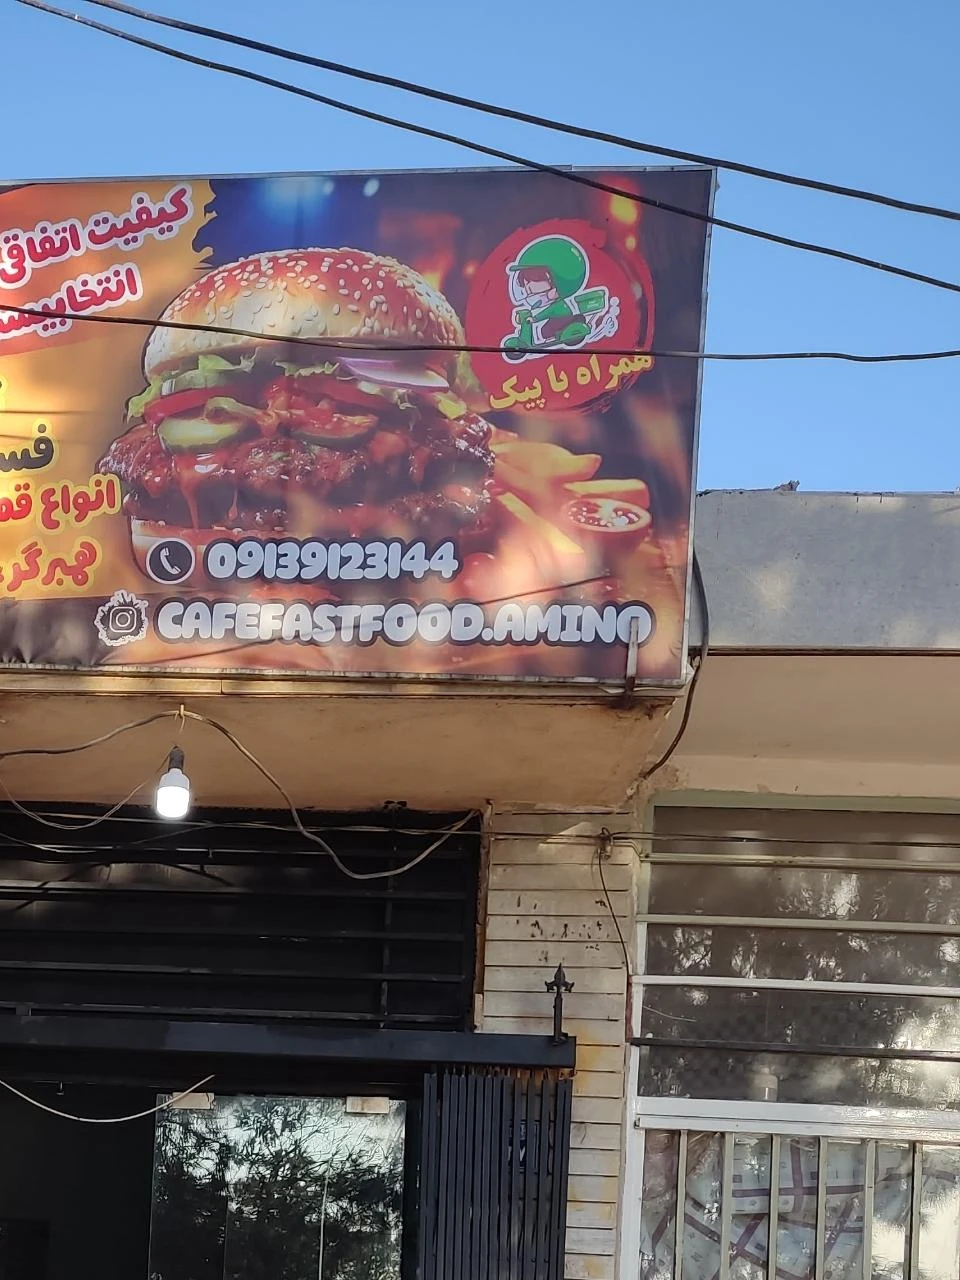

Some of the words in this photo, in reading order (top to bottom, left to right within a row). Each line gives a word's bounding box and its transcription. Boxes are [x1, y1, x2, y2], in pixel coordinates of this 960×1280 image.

[86, 186, 190, 246] کیفیت
[546, 363, 570, 399] با
[576, 348, 653, 390] همراه
[489, 375, 546, 410] پیک
[40, 479, 116, 530] انواع
[206, 541, 459, 580] 09139123144
[156, 601, 653, 643] CAFEFASTFOOD.AMINO
